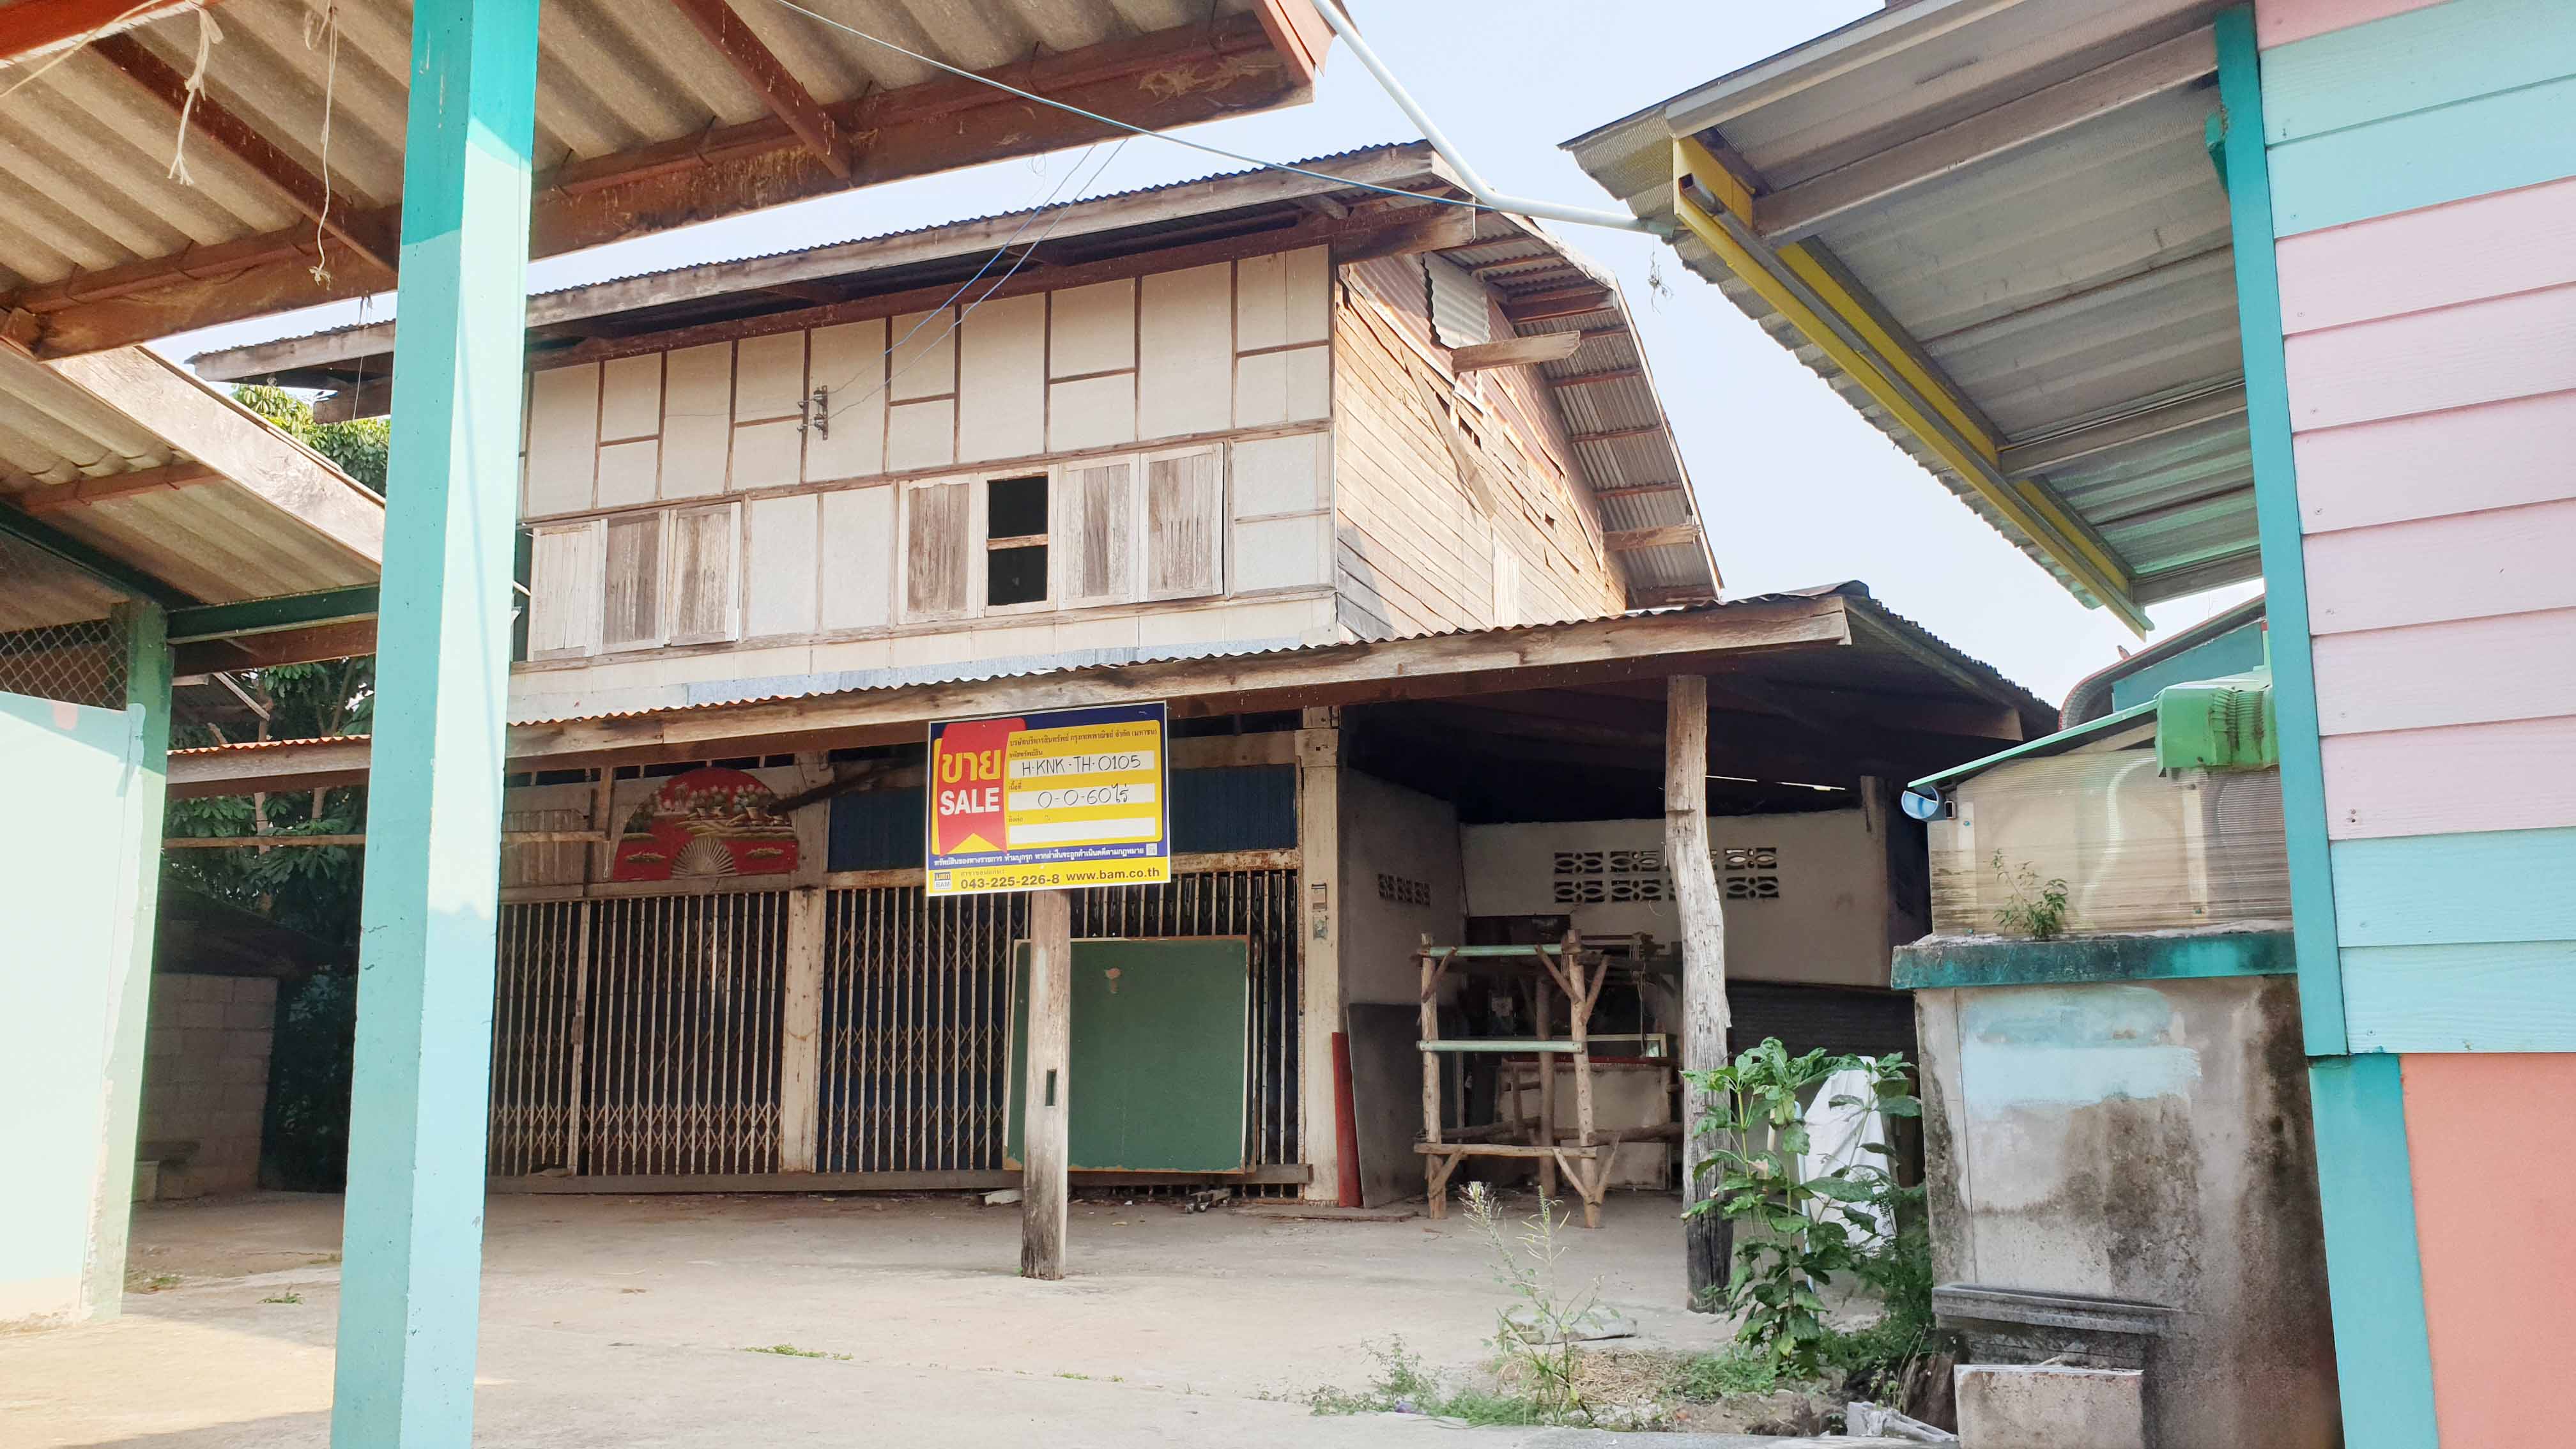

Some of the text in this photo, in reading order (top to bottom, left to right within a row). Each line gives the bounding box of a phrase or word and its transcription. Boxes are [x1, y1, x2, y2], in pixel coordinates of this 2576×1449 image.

[1116, 729, 1130, 738] จำกัด
[1131, 728, 1157, 737] (มหาชน)
[1009, 749, 1043, 758] รหัสทรัพย์สิน
[942, 749, 1002, 783] ขาย
[1008, 779, 1022, 790] เนื้อที่
[940, 787, 1000, 815] SALE
[1004, 853, 1032, 862] ห้ามบุกรุก
[1066, 867, 1160, 881] www.bam.co.th
[961, 874, 1059, 889] 043-225-226-8
